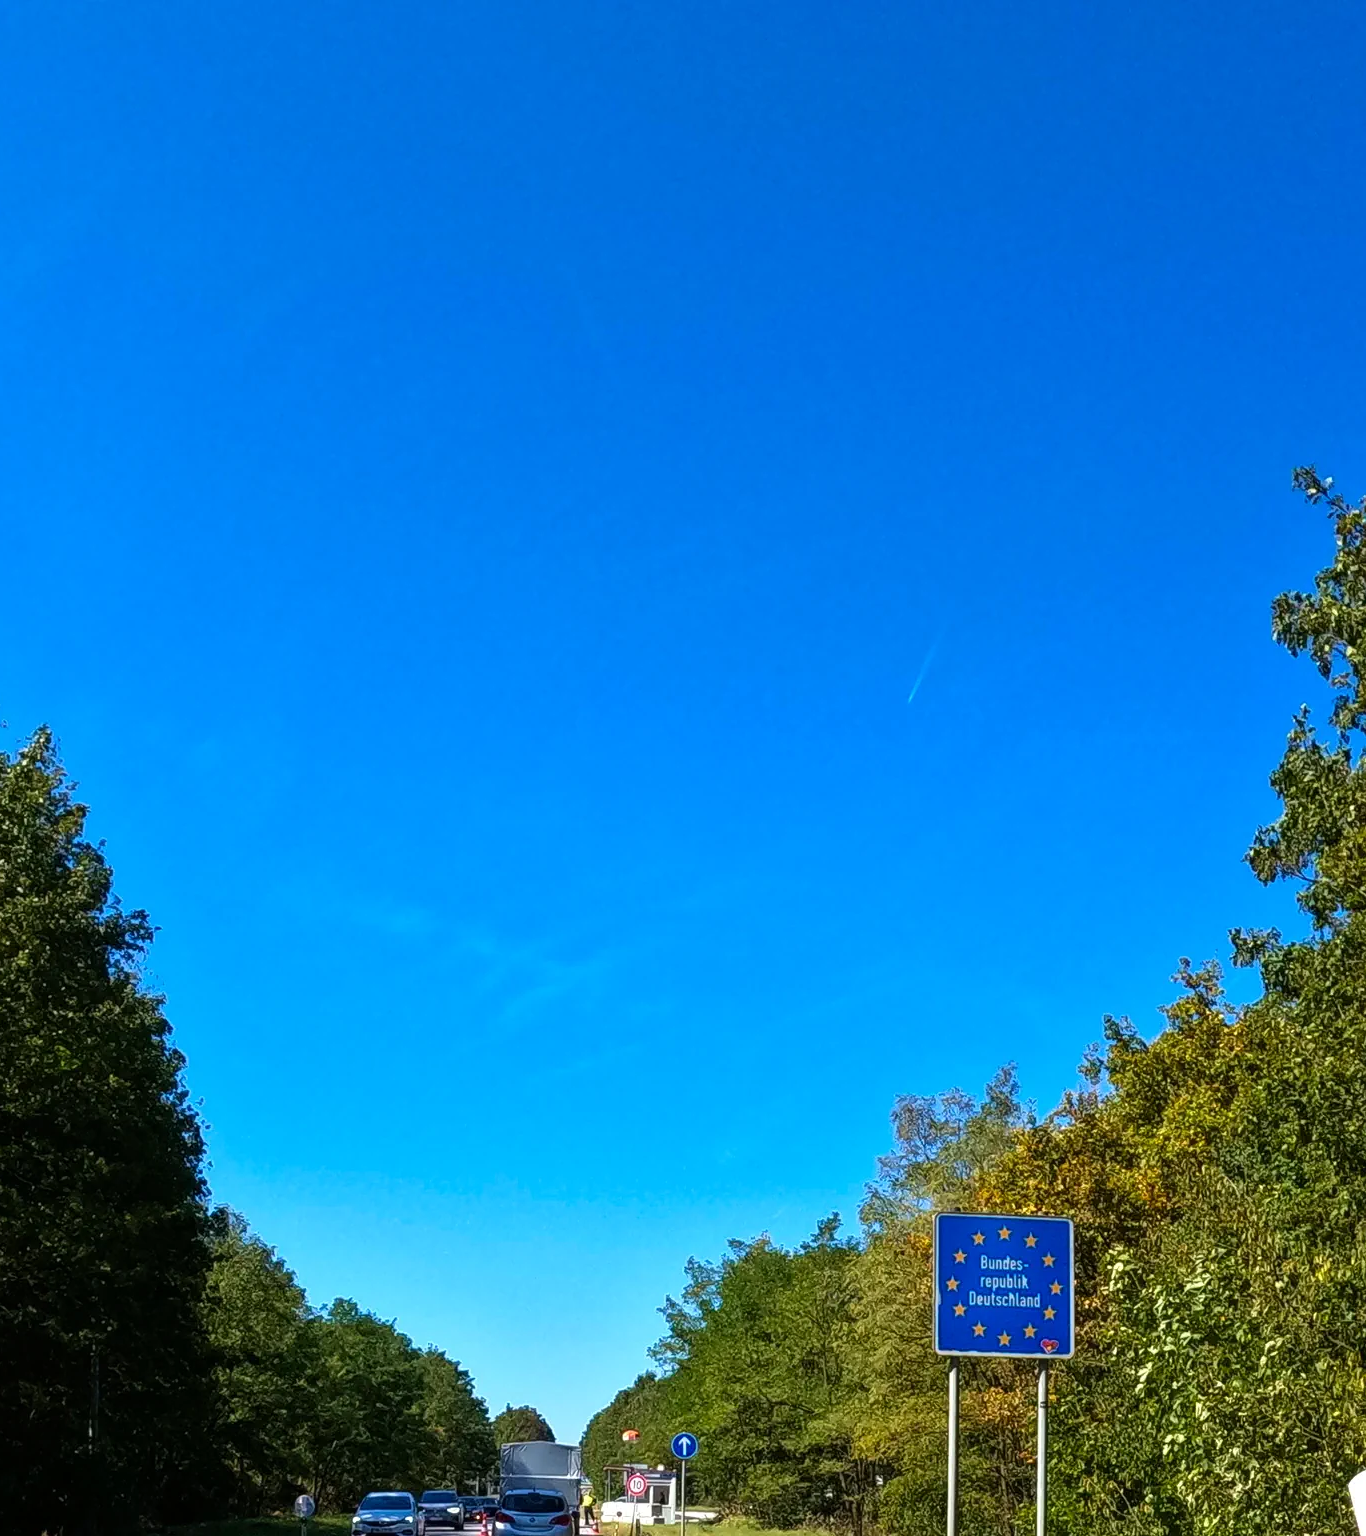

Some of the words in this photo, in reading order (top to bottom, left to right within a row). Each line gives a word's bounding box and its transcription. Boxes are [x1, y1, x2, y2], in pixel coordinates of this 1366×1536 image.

[980, 1255, 1029, 1270] Bundes-
[980, 1274, 1029, 1292] republik
[969, 1291, 1041, 1308] Deutschland
[633, 1480, 642, 1489] 10
